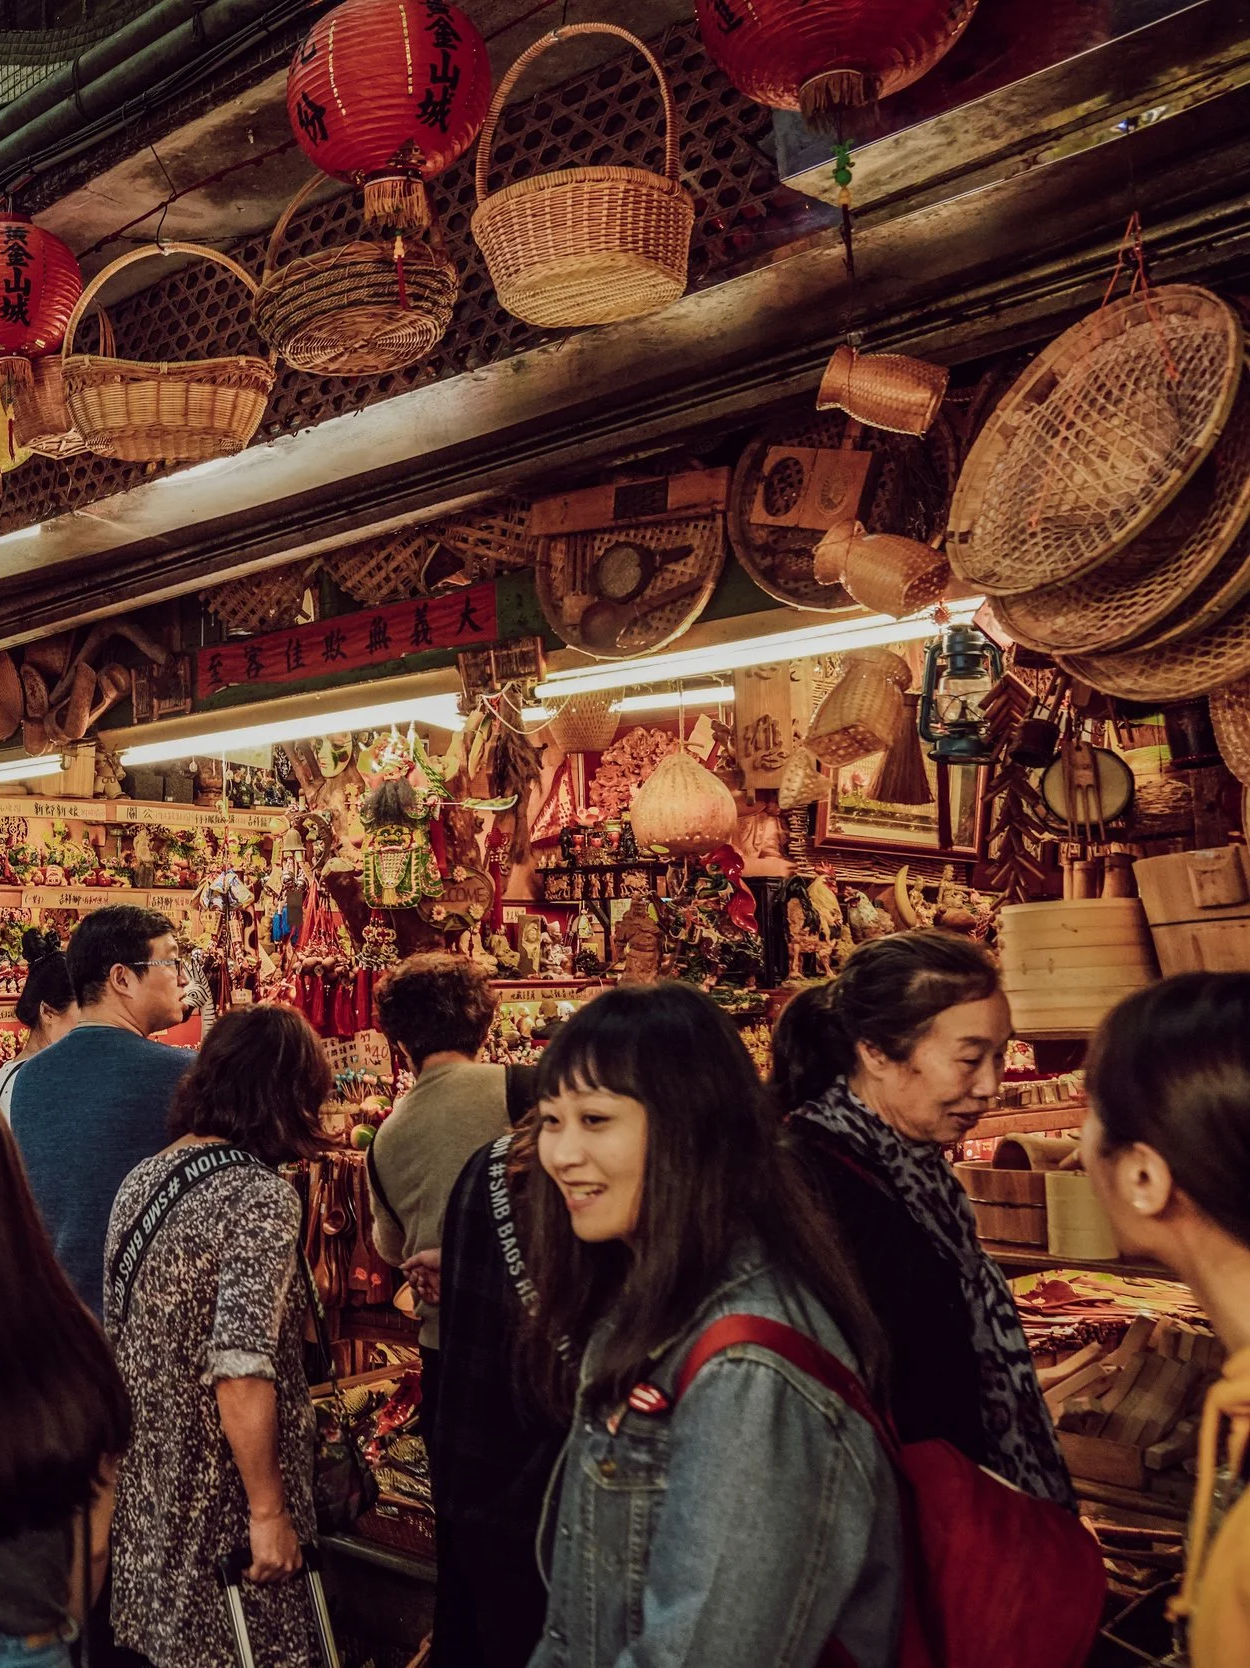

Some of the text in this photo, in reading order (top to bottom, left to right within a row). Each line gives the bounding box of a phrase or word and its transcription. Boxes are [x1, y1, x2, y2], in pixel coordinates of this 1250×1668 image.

[142, 1176, 181, 1235] #SMB
[488, 1162, 511, 1220] #SMB
[119, 1231, 144, 1281] BAGS
[497, 1220, 526, 1276] BAGS
